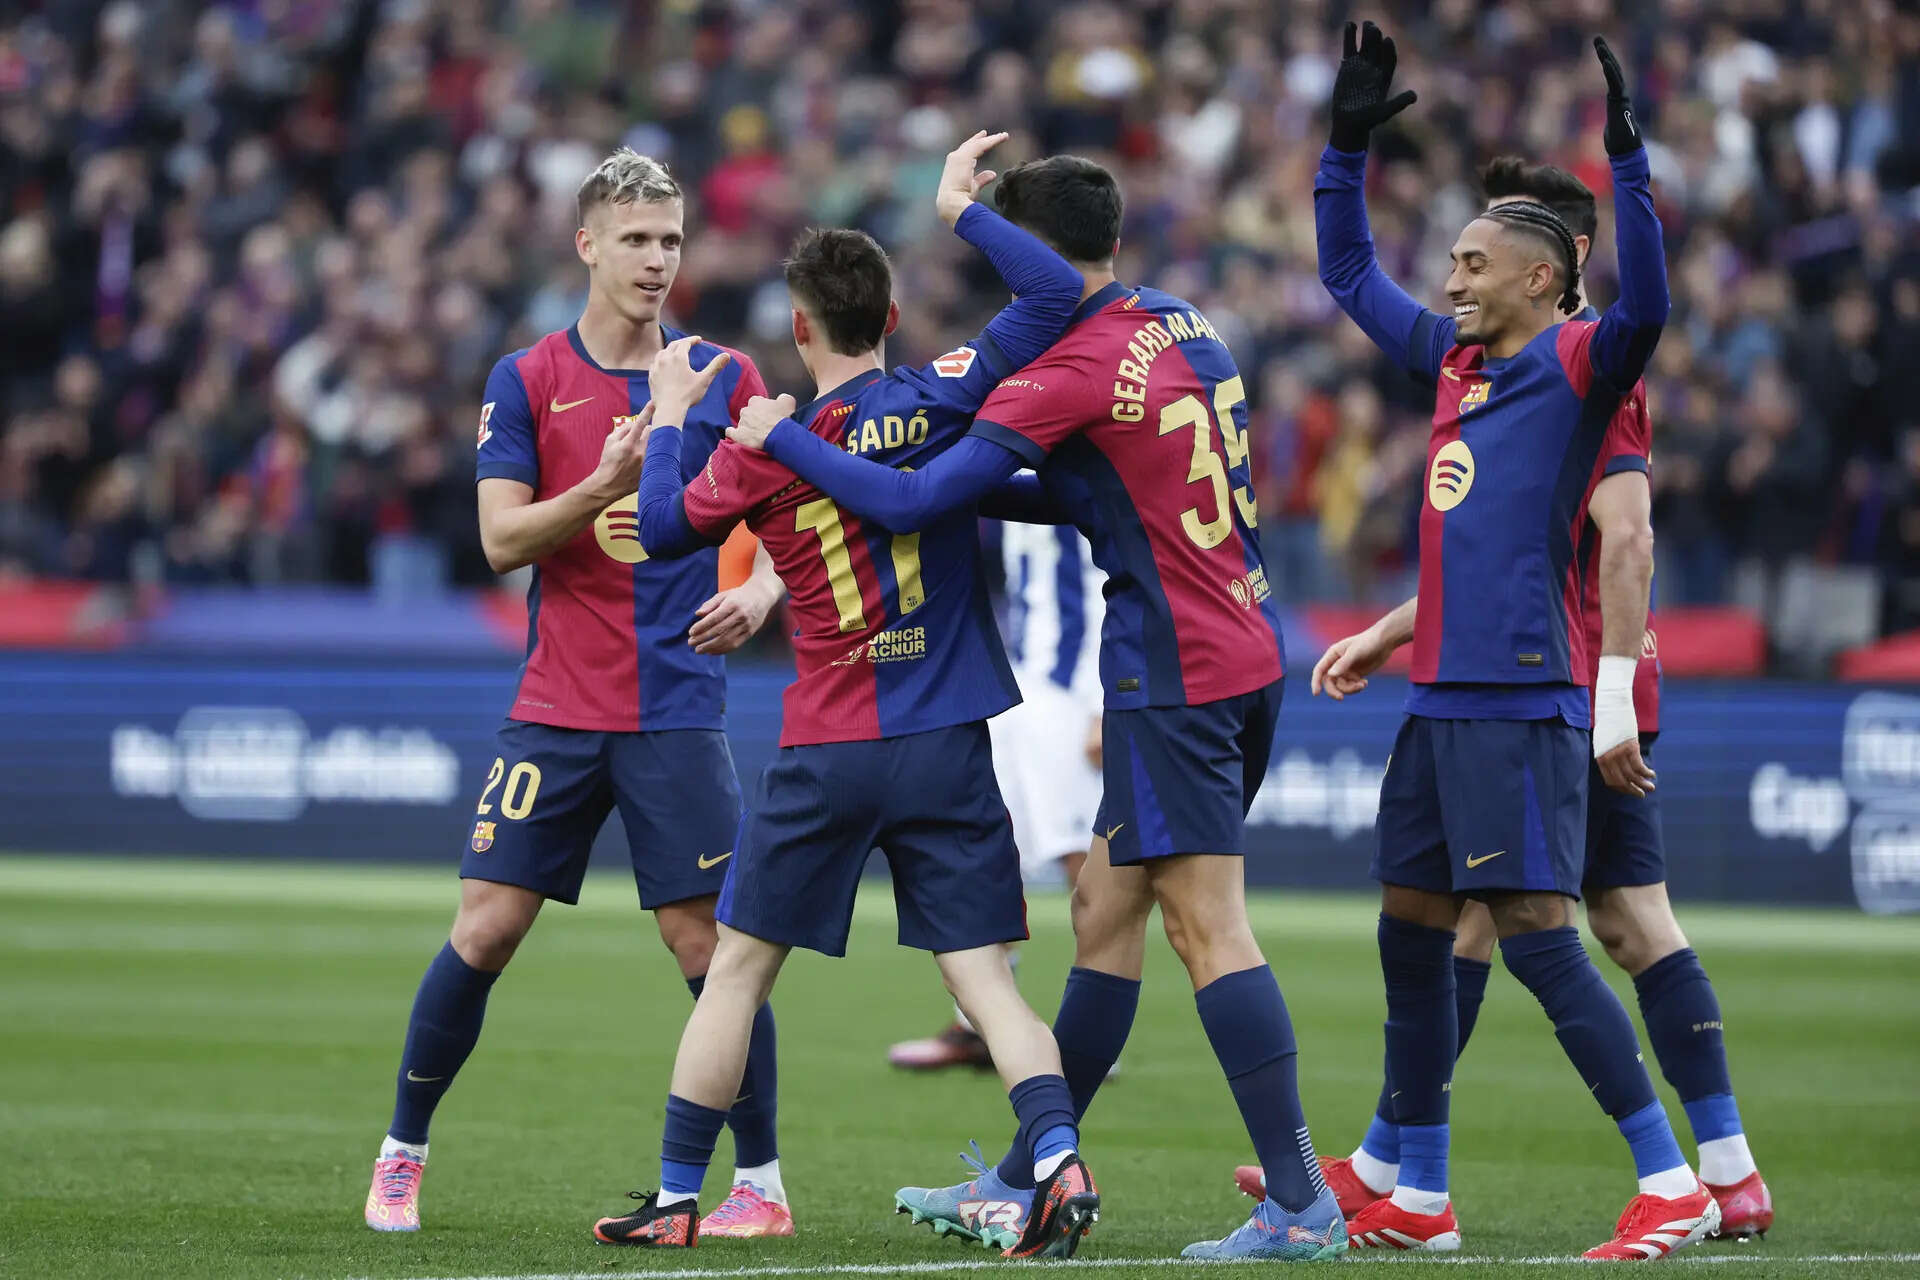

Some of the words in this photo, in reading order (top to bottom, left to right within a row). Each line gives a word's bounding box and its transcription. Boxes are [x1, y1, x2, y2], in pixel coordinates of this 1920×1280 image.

[1112, 321, 1173, 422] GERARD
[836, 409, 929, 456] SADÓ
[1158, 375, 1258, 550] 35
[866, 640, 926, 658] ACNUR
[477, 756, 542, 820] 20
